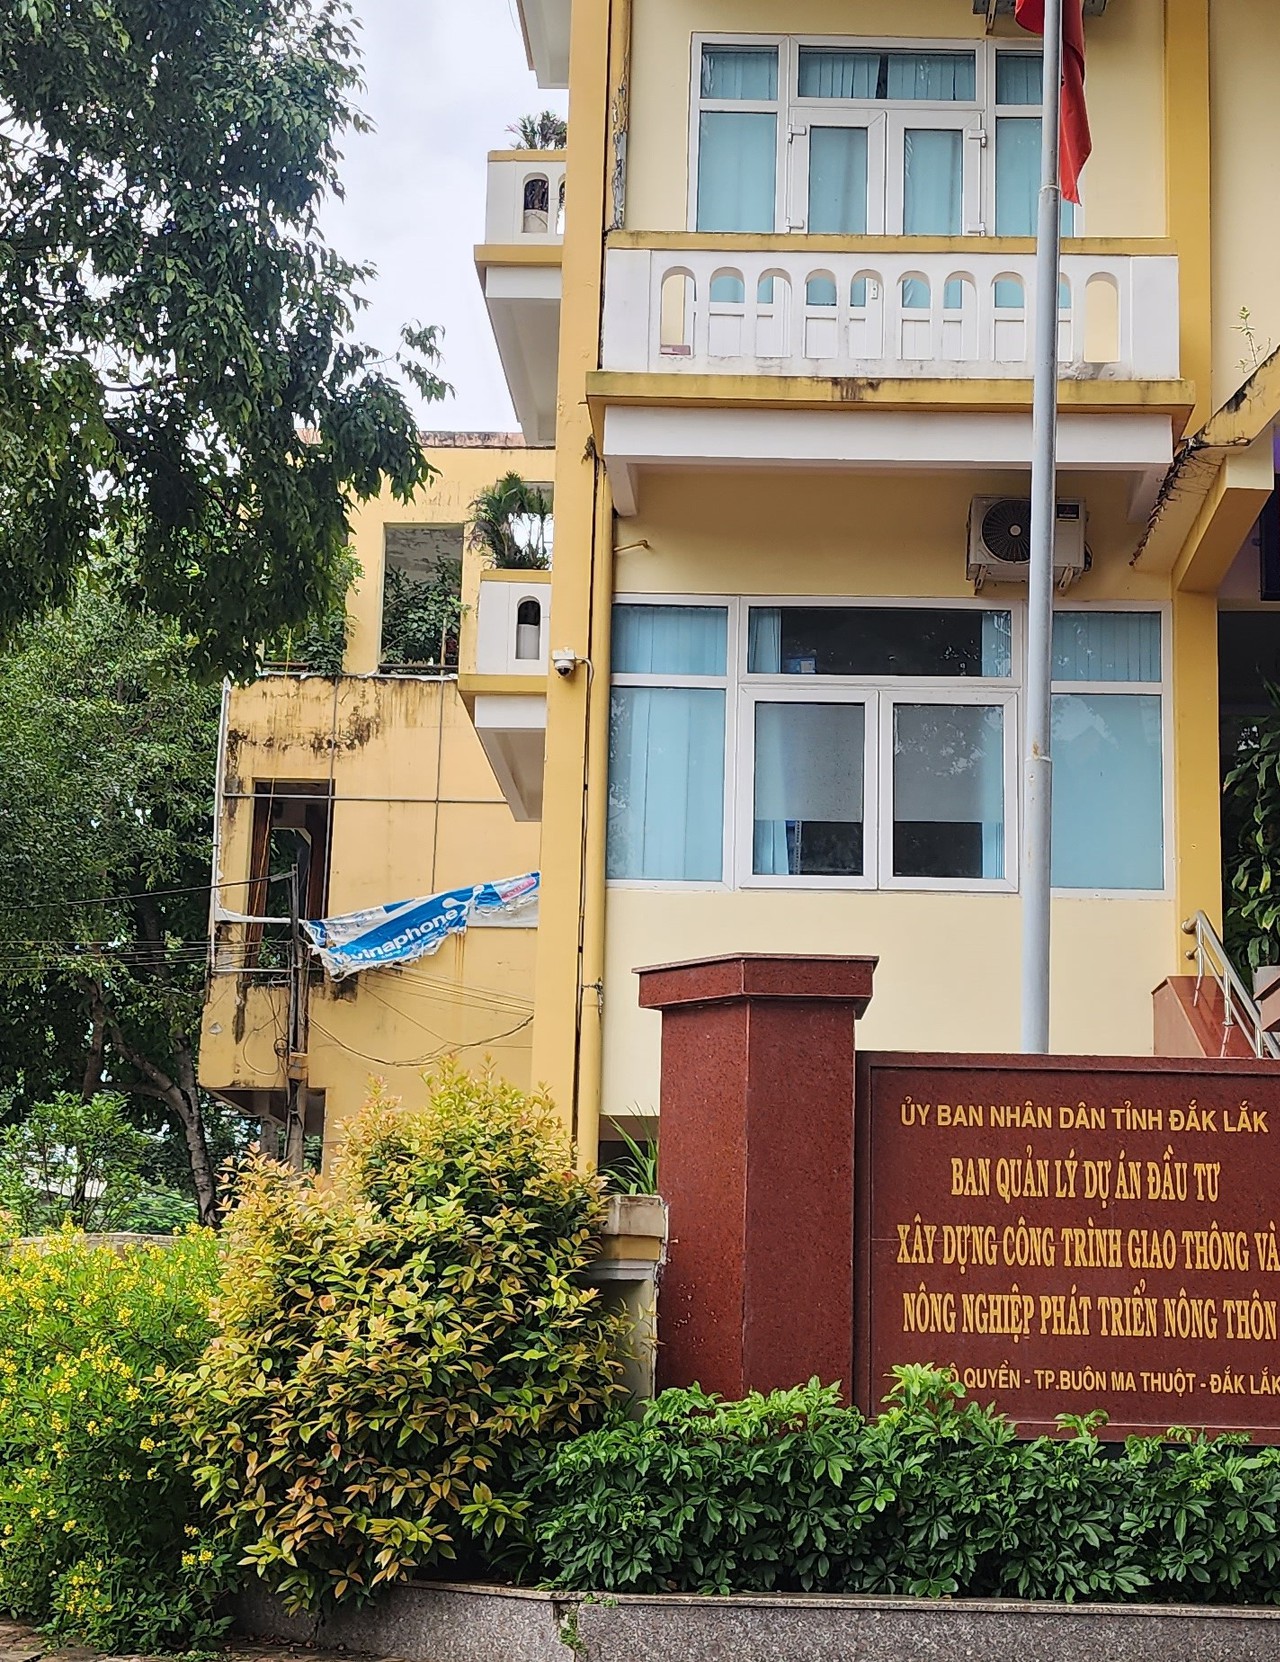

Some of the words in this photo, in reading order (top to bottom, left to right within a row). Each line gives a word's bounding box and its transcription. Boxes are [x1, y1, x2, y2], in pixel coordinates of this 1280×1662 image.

[350, 909, 457, 960] vinaphone
[901, 1096, 931, 1126] ỦY
[937, 1104, 984, 1127] BAN
[990, 1100, 1052, 1129] NHÂN
[1059, 1101, 1106, 1130] DÂN
[1111, 1100, 1163, 1131] TỈNH
[1168, 1099, 1217, 1132] ĐẮK
[1223, 1100, 1269, 1133] LẮK
[950, 1157, 991, 1196] BAN
[995, 1144, 1050, 1204] QUẢN
[1054, 1148, 1078, 1198] LÝ
[1081, 1159, 1112, 1209] DỰ
[1114, 1149, 1142, 1200] ÁN
[1146, 1144, 1188, 1202] ĐẦU
[1193, 1161, 1221, 1202] TƯ
[896, 1213, 938, 1264] XÂY
[942, 1223, 998, 1275] DỰNG
[1002, 1216, 1056, 1267] CÔNG
[1060, 1216, 1123, 1268] TRÌNH
[1127, 1228, 1177, 1270] GIAO
[1181, 1220, 1250, 1272] THÔNG
[1253, 1220, 1280, 1272] VÀ
[902, 1281, 957, 1334] NÔNG
[961, 1283, 1035, 1344] NGHIỆP
[1039, 1283, 1092, 1336] PHÁT
[1097, 1278, 1158, 1337] TRIỂN
[1163, 1287, 1218, 1339] NÔNG
[1222, 1289, 1277, 1341] THÔN
[962, 1359, 1021, 1392] QUYỀN
[1033, 1365, 1107, 1391] TP.BUÔN
[1111, 1371, 1137, 1392] MA
[1139, 1369, 1197, 1398] THUỘT
[1209, 1365, 1246, 1395] ĐẮK
